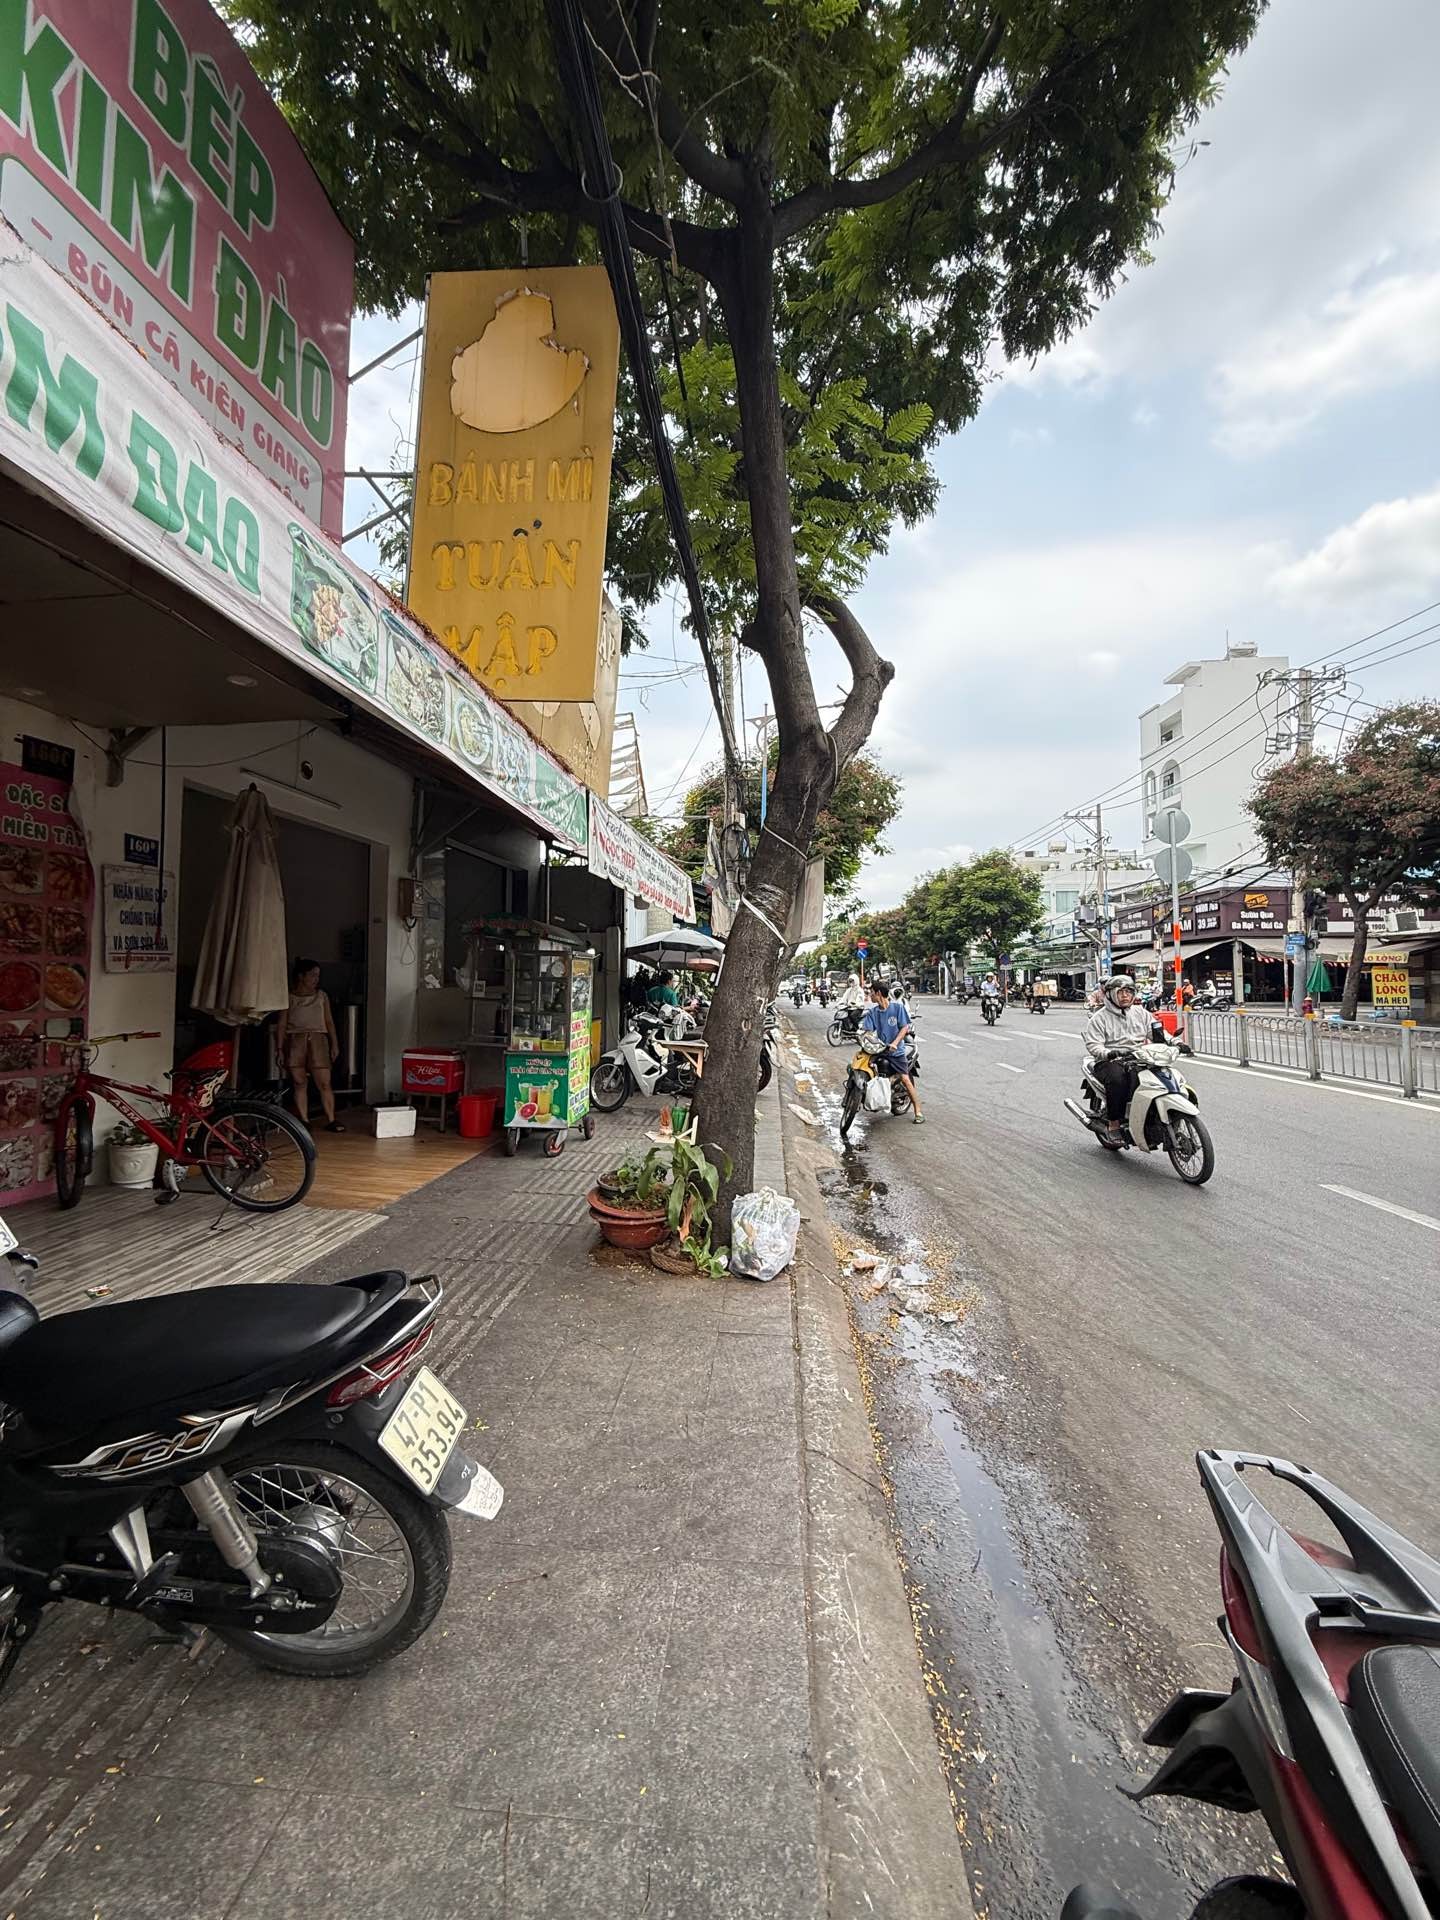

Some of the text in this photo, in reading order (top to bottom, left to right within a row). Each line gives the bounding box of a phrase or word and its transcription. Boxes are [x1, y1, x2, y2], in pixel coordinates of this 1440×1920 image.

[129, 0, 277, 242] BẾP
[0, 0, 335, 450] KIM ĐÀO
[67, 243, 311, 490] BÚN CÁ KIÊN GIANG
[0, 303, 261, 596] M ĐÀO
[429, 445, 594, 506] BÁNH MÌ
[430, 519, 582, 592] TUẤN
[443, 610, 559, 690] MẬP
[2, 811, 48, 842] MIỀN
[6, 783, 46, 810] ĐẶC
[1374, 971, 1406, 982] CHÁO
[1375, 983, 1407, 995] LÒNG
[1391, 996, 1408, 1005] HEO
[392, 1380, 440, 1450] 47-P1
[411, 1399, 464, 1485] 353.94
